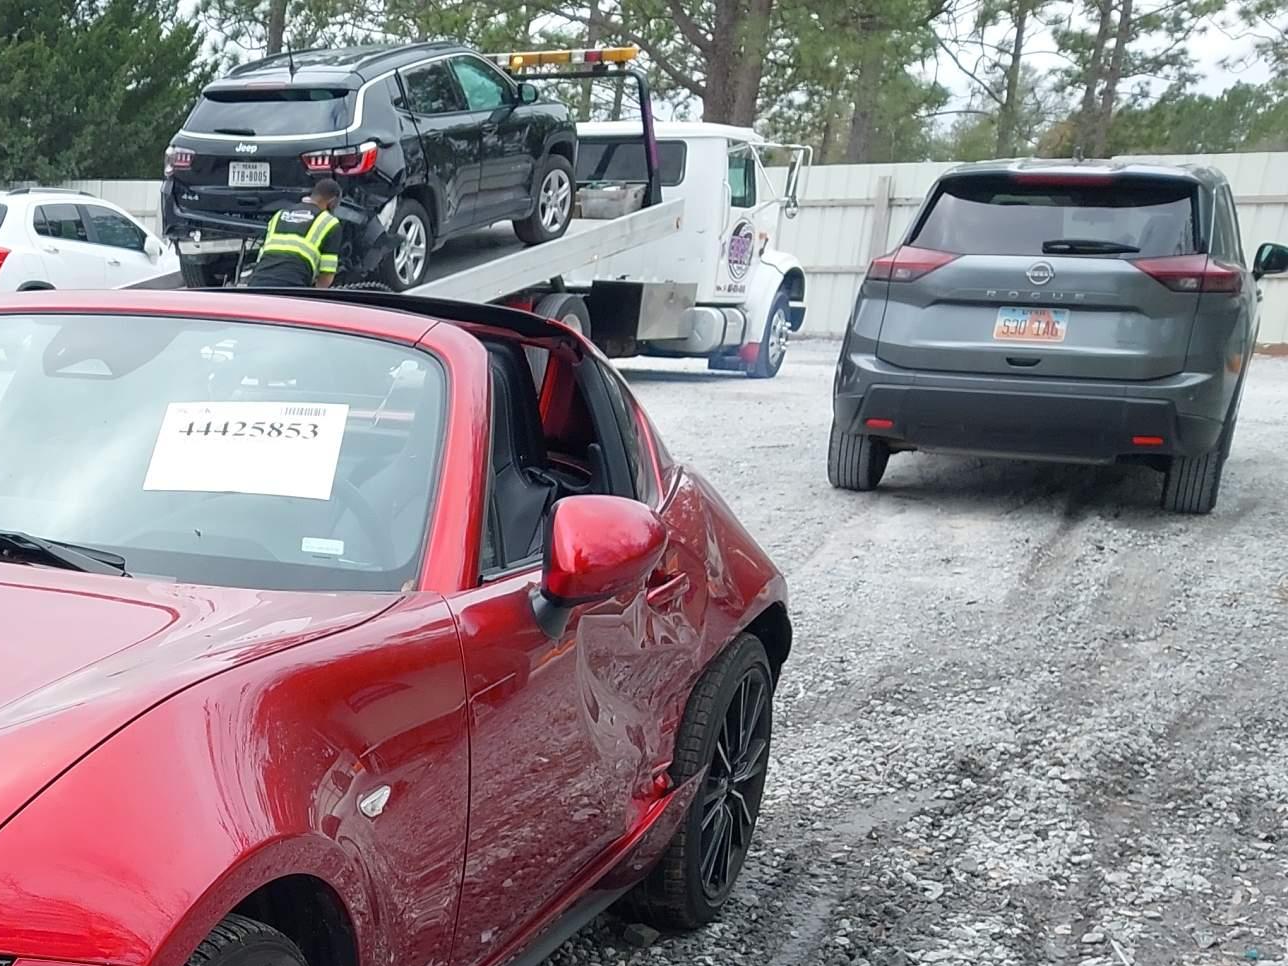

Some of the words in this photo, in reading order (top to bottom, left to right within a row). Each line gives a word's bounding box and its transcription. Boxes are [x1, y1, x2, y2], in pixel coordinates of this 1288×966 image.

[235, 142, 257, 154] Jeep
[986, 290, 1085, 300] ROGUE
[178, 420, 320, 440] 44425853
